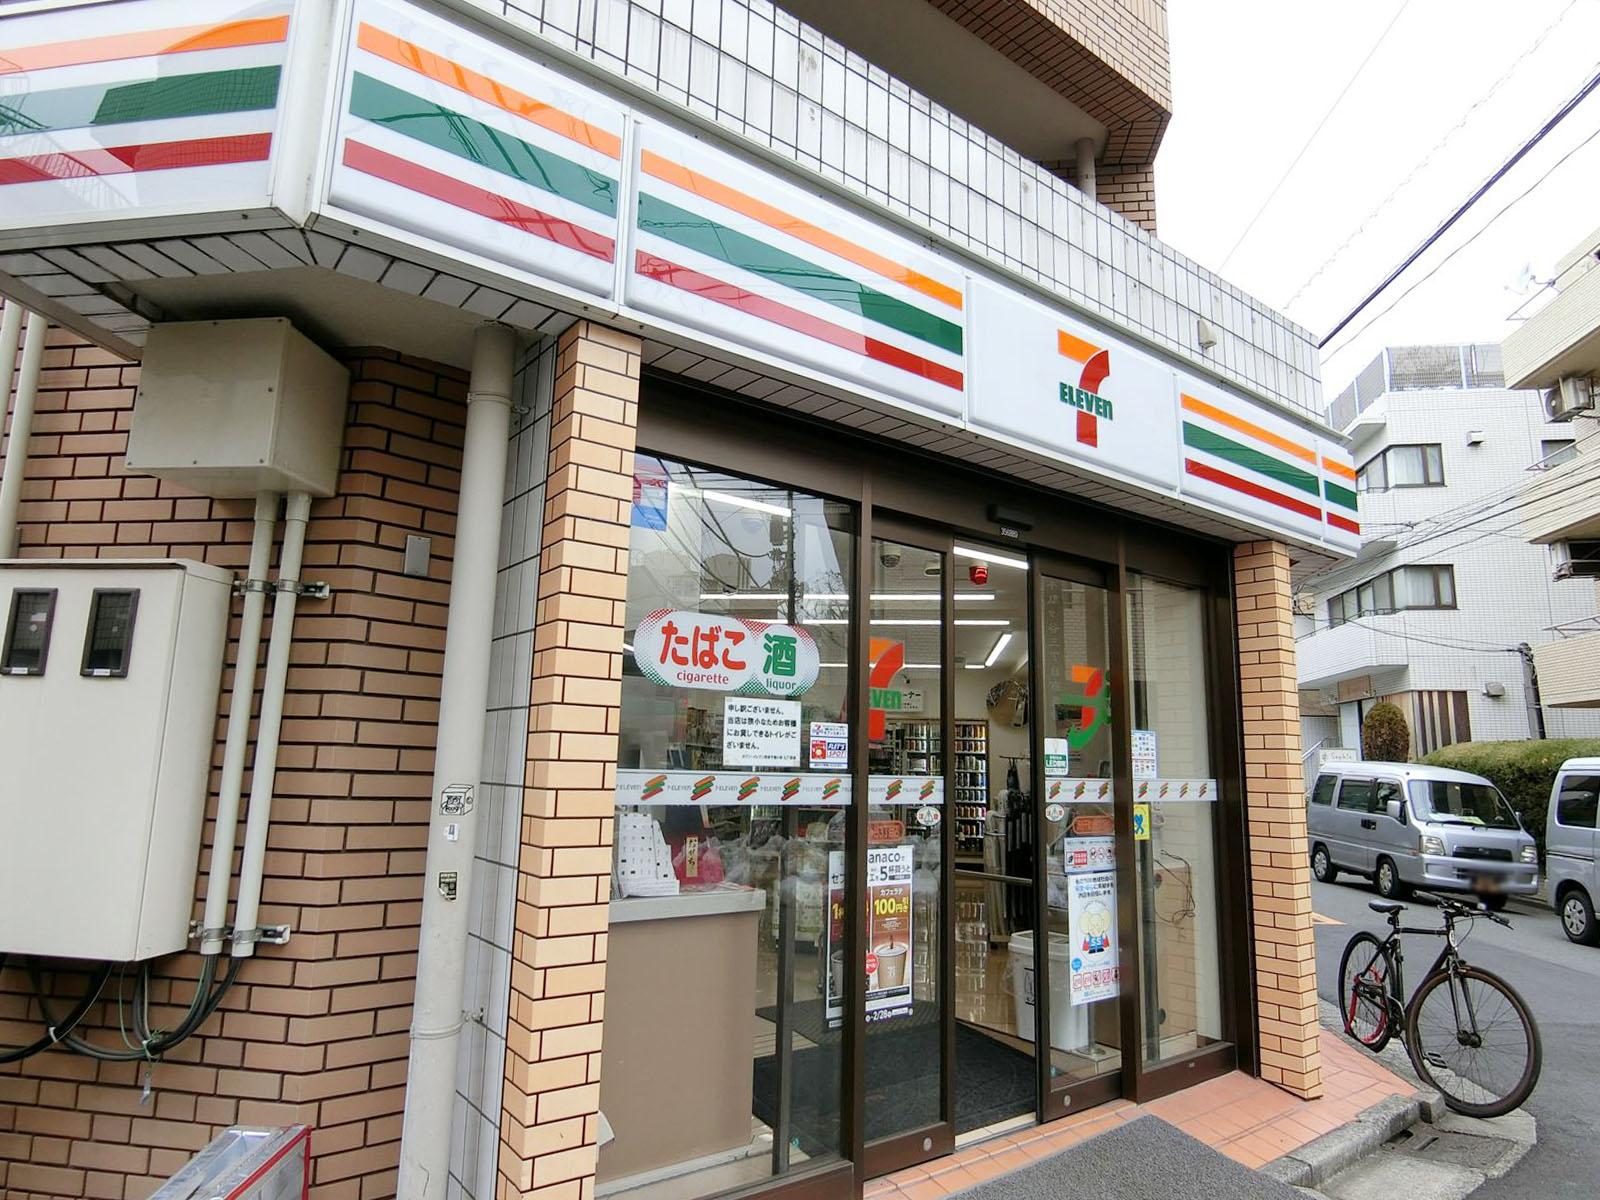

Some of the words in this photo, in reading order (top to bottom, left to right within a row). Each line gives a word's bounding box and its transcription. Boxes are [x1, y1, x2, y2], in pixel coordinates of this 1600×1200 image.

[1058, 329, 1110, 448] 7
[660, 620, 747, 670] たばこ
[763, 632, 797, 677] 酒
[676, 670, 729, 685] cigarette
[766, 677, 797, 691] liquor
[726, 728, 797, 740] にお貸しできるトイレがご
